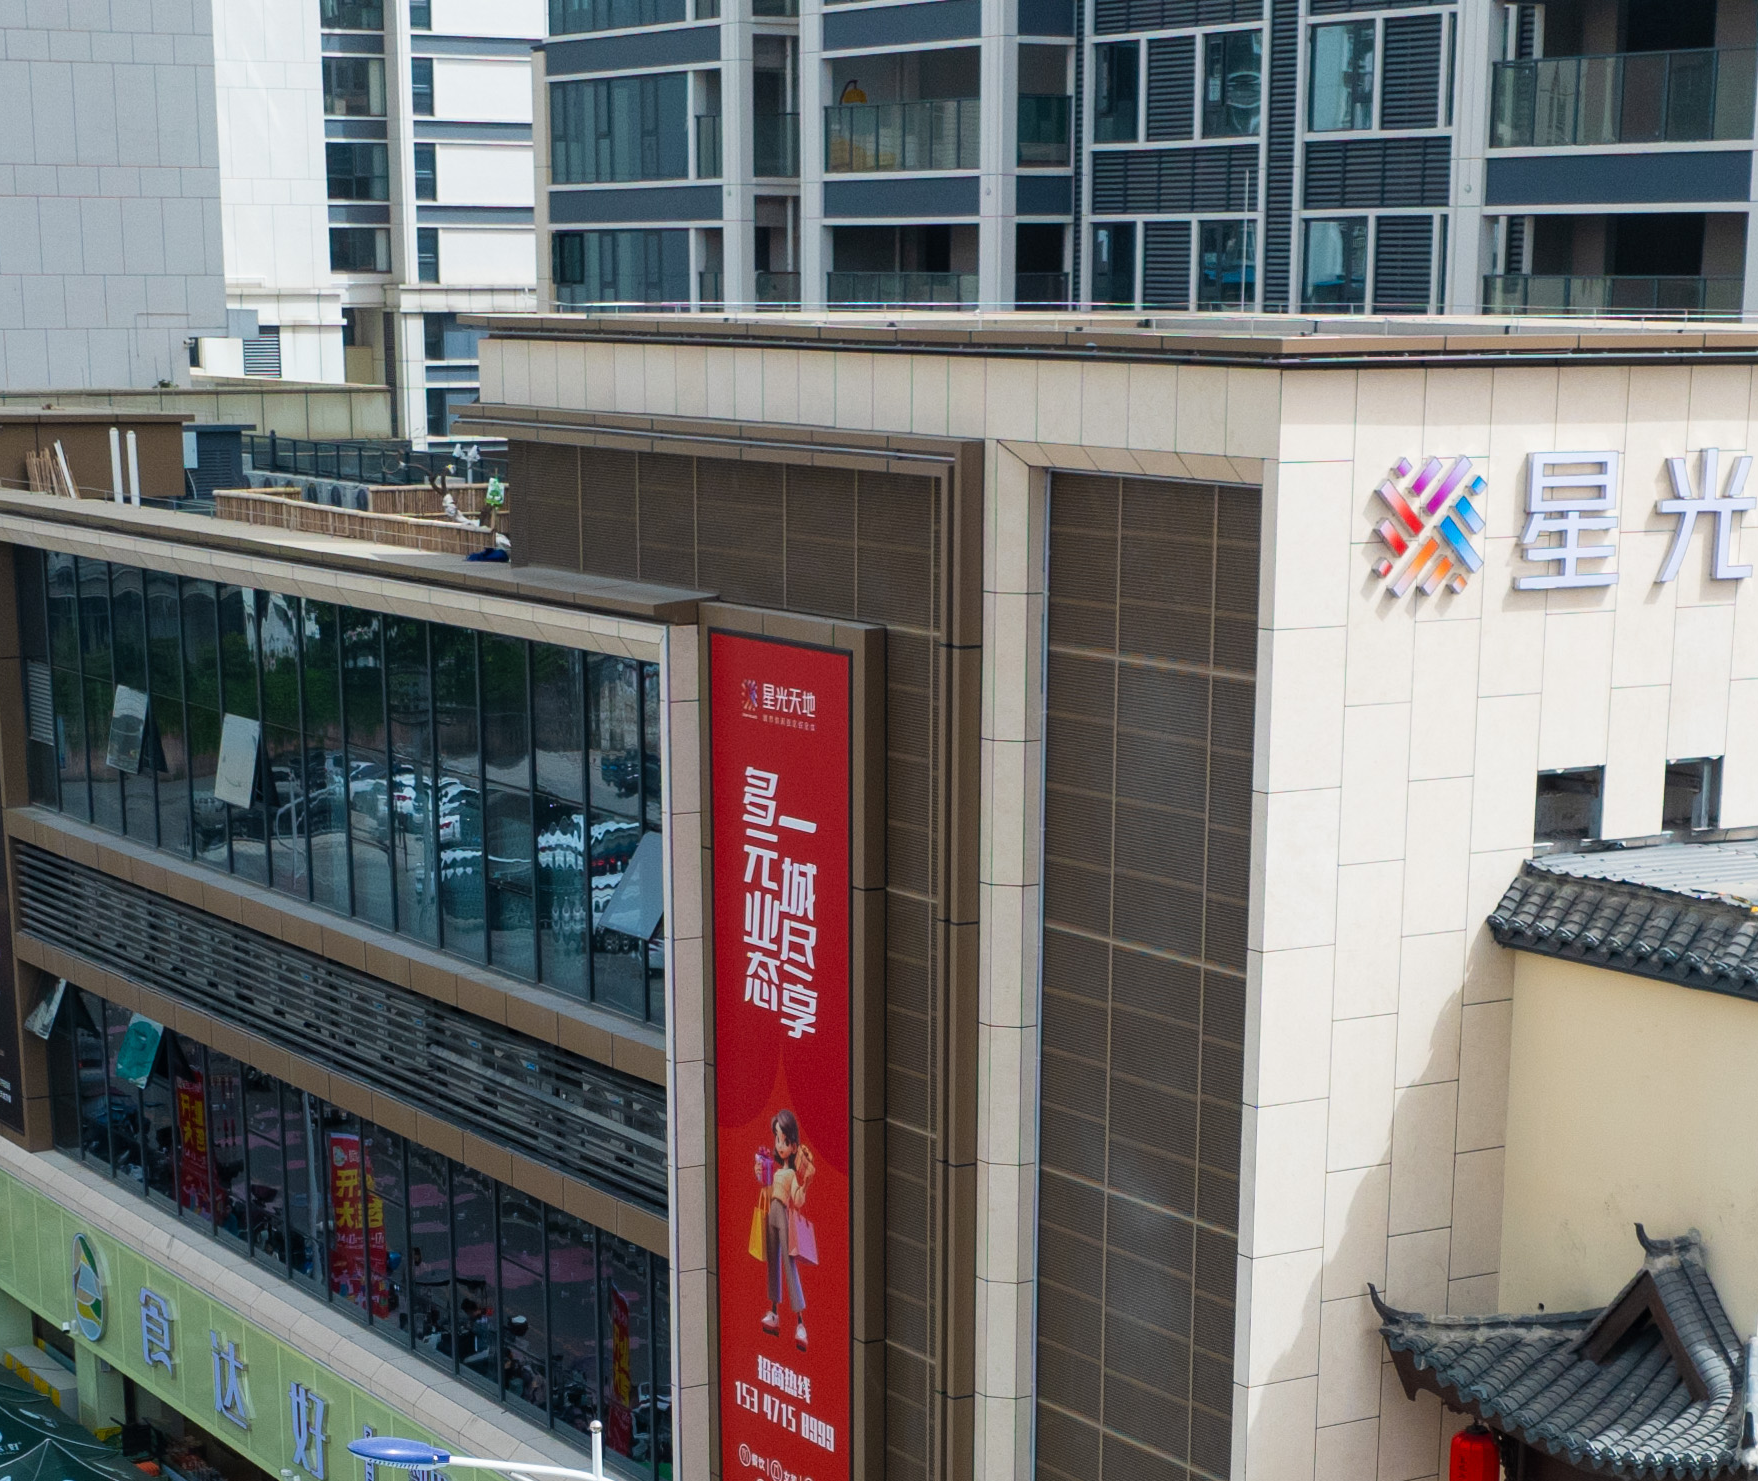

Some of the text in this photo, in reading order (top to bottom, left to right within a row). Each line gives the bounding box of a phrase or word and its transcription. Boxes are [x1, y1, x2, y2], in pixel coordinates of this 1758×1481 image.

[762, 683, 817, 719] 星光天地
[743, 766, 781, 1011] 多元业态
[778, 815, 819, 1039] 一城尽享
[139, 1286, 328, 1481] 食达好
[735, 1381, 835, 1452] 153 4715 8999
[757, 1355, 811, 1404] 招商热线
